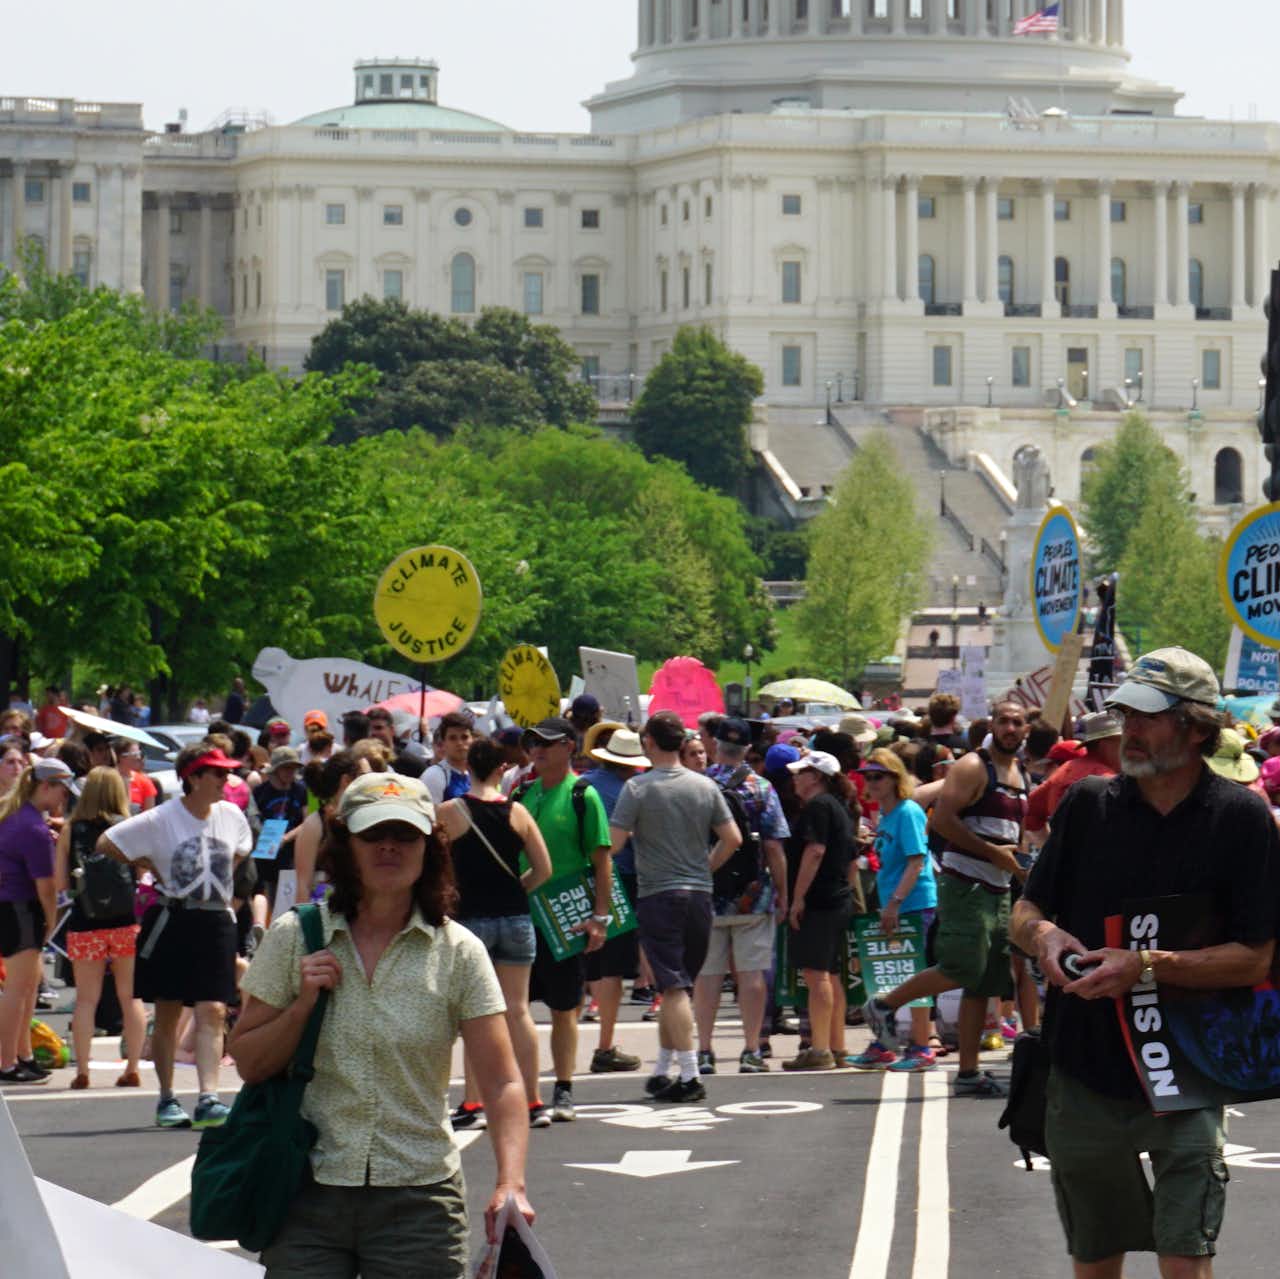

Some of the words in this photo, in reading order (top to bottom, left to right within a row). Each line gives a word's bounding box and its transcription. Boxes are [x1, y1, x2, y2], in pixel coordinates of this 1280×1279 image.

[390, 554, 468, 594] CLIMATE
[1036, 559, 1079, 598] CLIMATE
[389, 616, 467, 655] JUSTICE
[503, 649, 550, 695] CLIMATE
[1249, 651, 1278, 663] NOT
[1237, 677, 1280, 691] POLICY
[569, 884, 594, 924] ISE
[867, 939, 915, 956] VOTE
[872, 959, 915, 975] RISE
[1130, 913, 1162, 1033] SIES
[1141, 1041, 1181, 1097] NO
